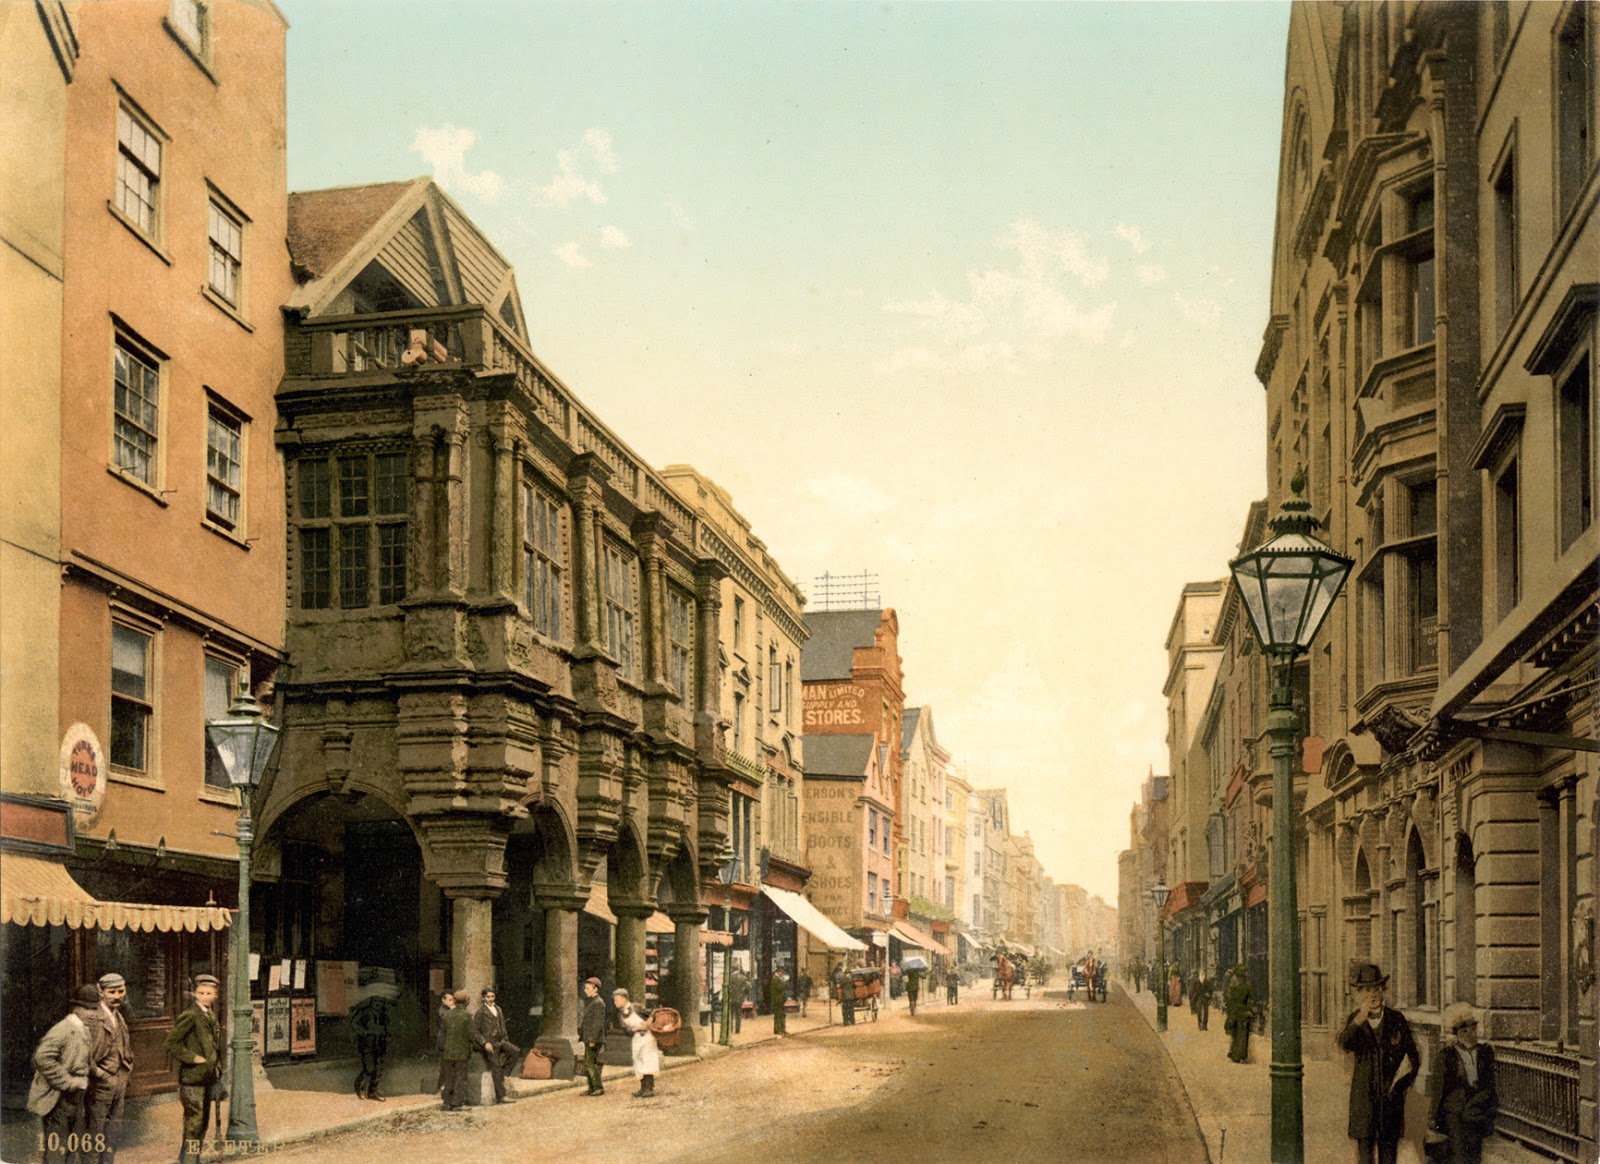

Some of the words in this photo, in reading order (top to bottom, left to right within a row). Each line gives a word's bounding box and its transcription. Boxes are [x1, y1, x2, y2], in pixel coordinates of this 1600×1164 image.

[828, 684, 865, 699] LIMITED
[837, 700, 858, 709] AND
[804, 709, 865, 725] STORES.
[71, 760, 98, 777] HEAD
[807, 835, 852, 849] BOOTS
[809, 875, 852, 888] SHOES
